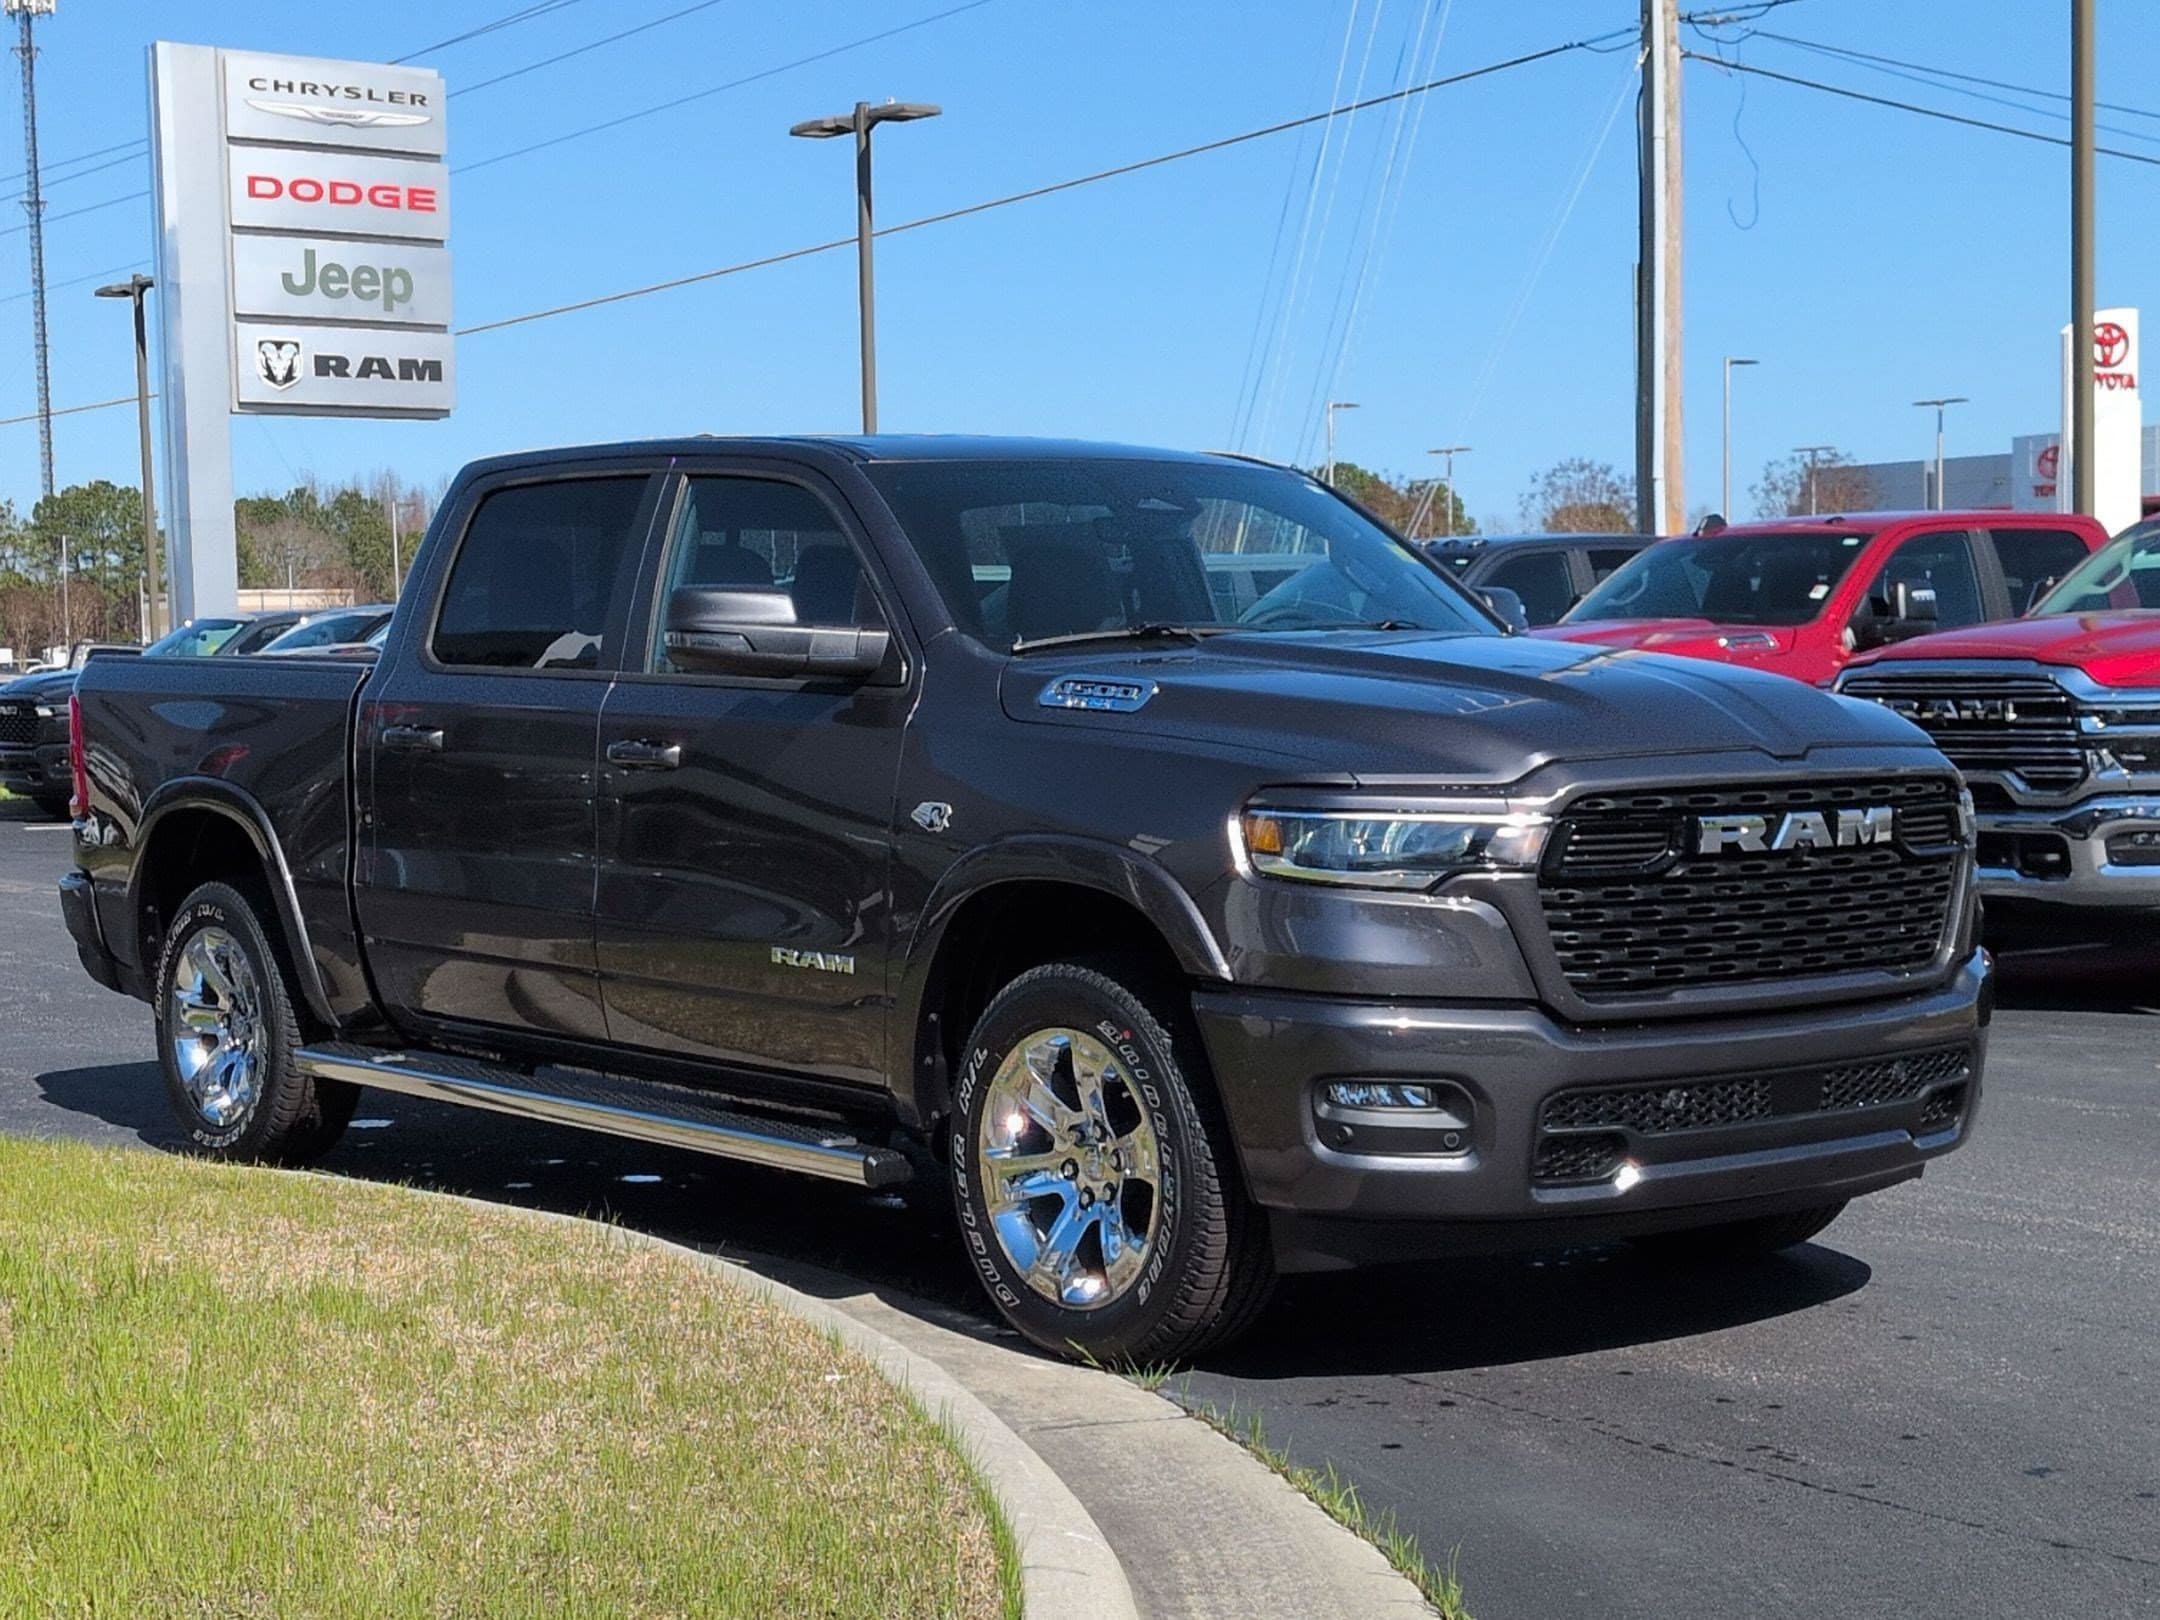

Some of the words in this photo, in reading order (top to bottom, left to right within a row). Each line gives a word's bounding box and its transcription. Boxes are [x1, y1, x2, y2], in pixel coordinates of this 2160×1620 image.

[248, 77, 428, 107] CHRYSLER
[247, 175, 437, 212] DODGE
[281, 248, 414, 312] Jeep
[314, 354, 443, 382] RAM
[2094, 373, 2136, 390] YOTA
[1698, 807, 1893, 854] RAM
[771, 946, 855, 975] RAM
